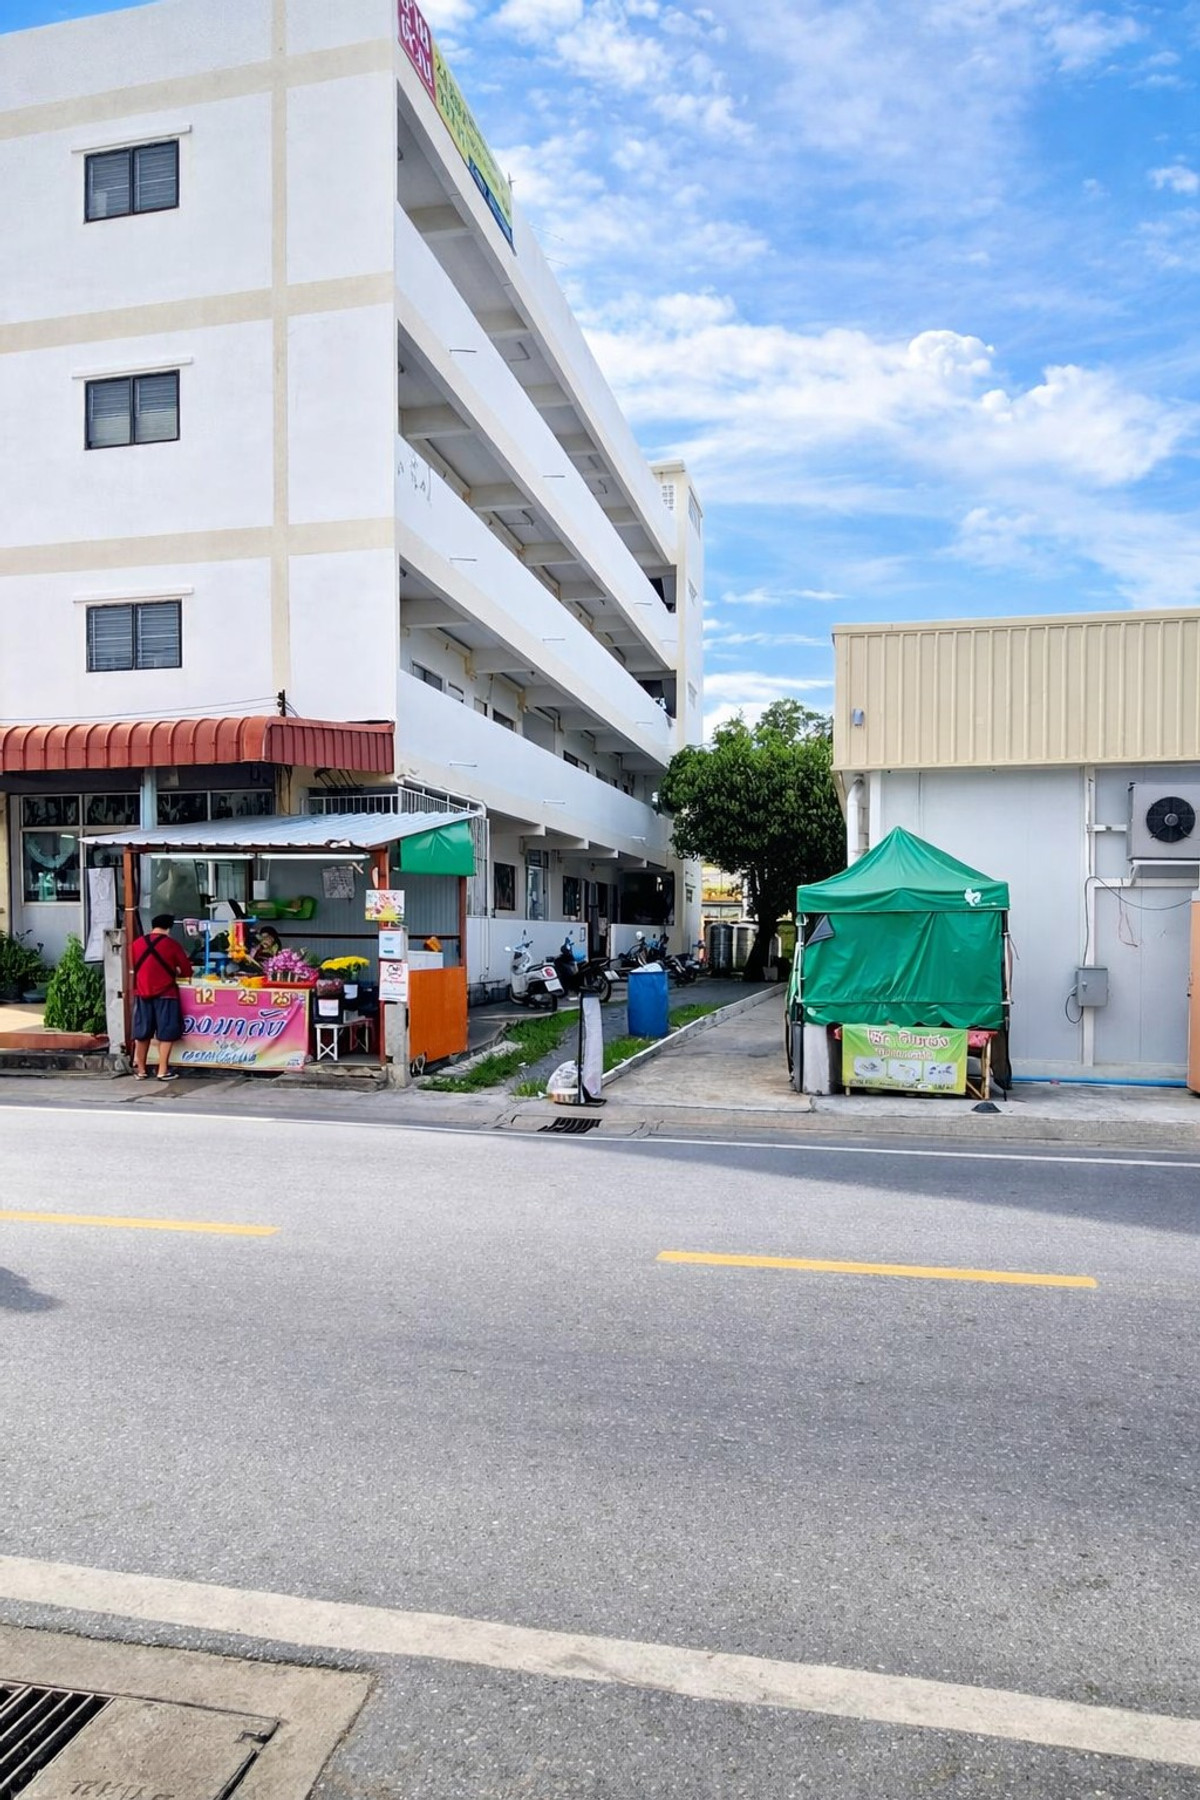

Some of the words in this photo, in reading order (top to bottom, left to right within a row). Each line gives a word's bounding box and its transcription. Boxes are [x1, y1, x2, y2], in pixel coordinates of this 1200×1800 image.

[238, 989, 256, 1005] 25
[182, 1008, 290, 1038] วงมาลัย
